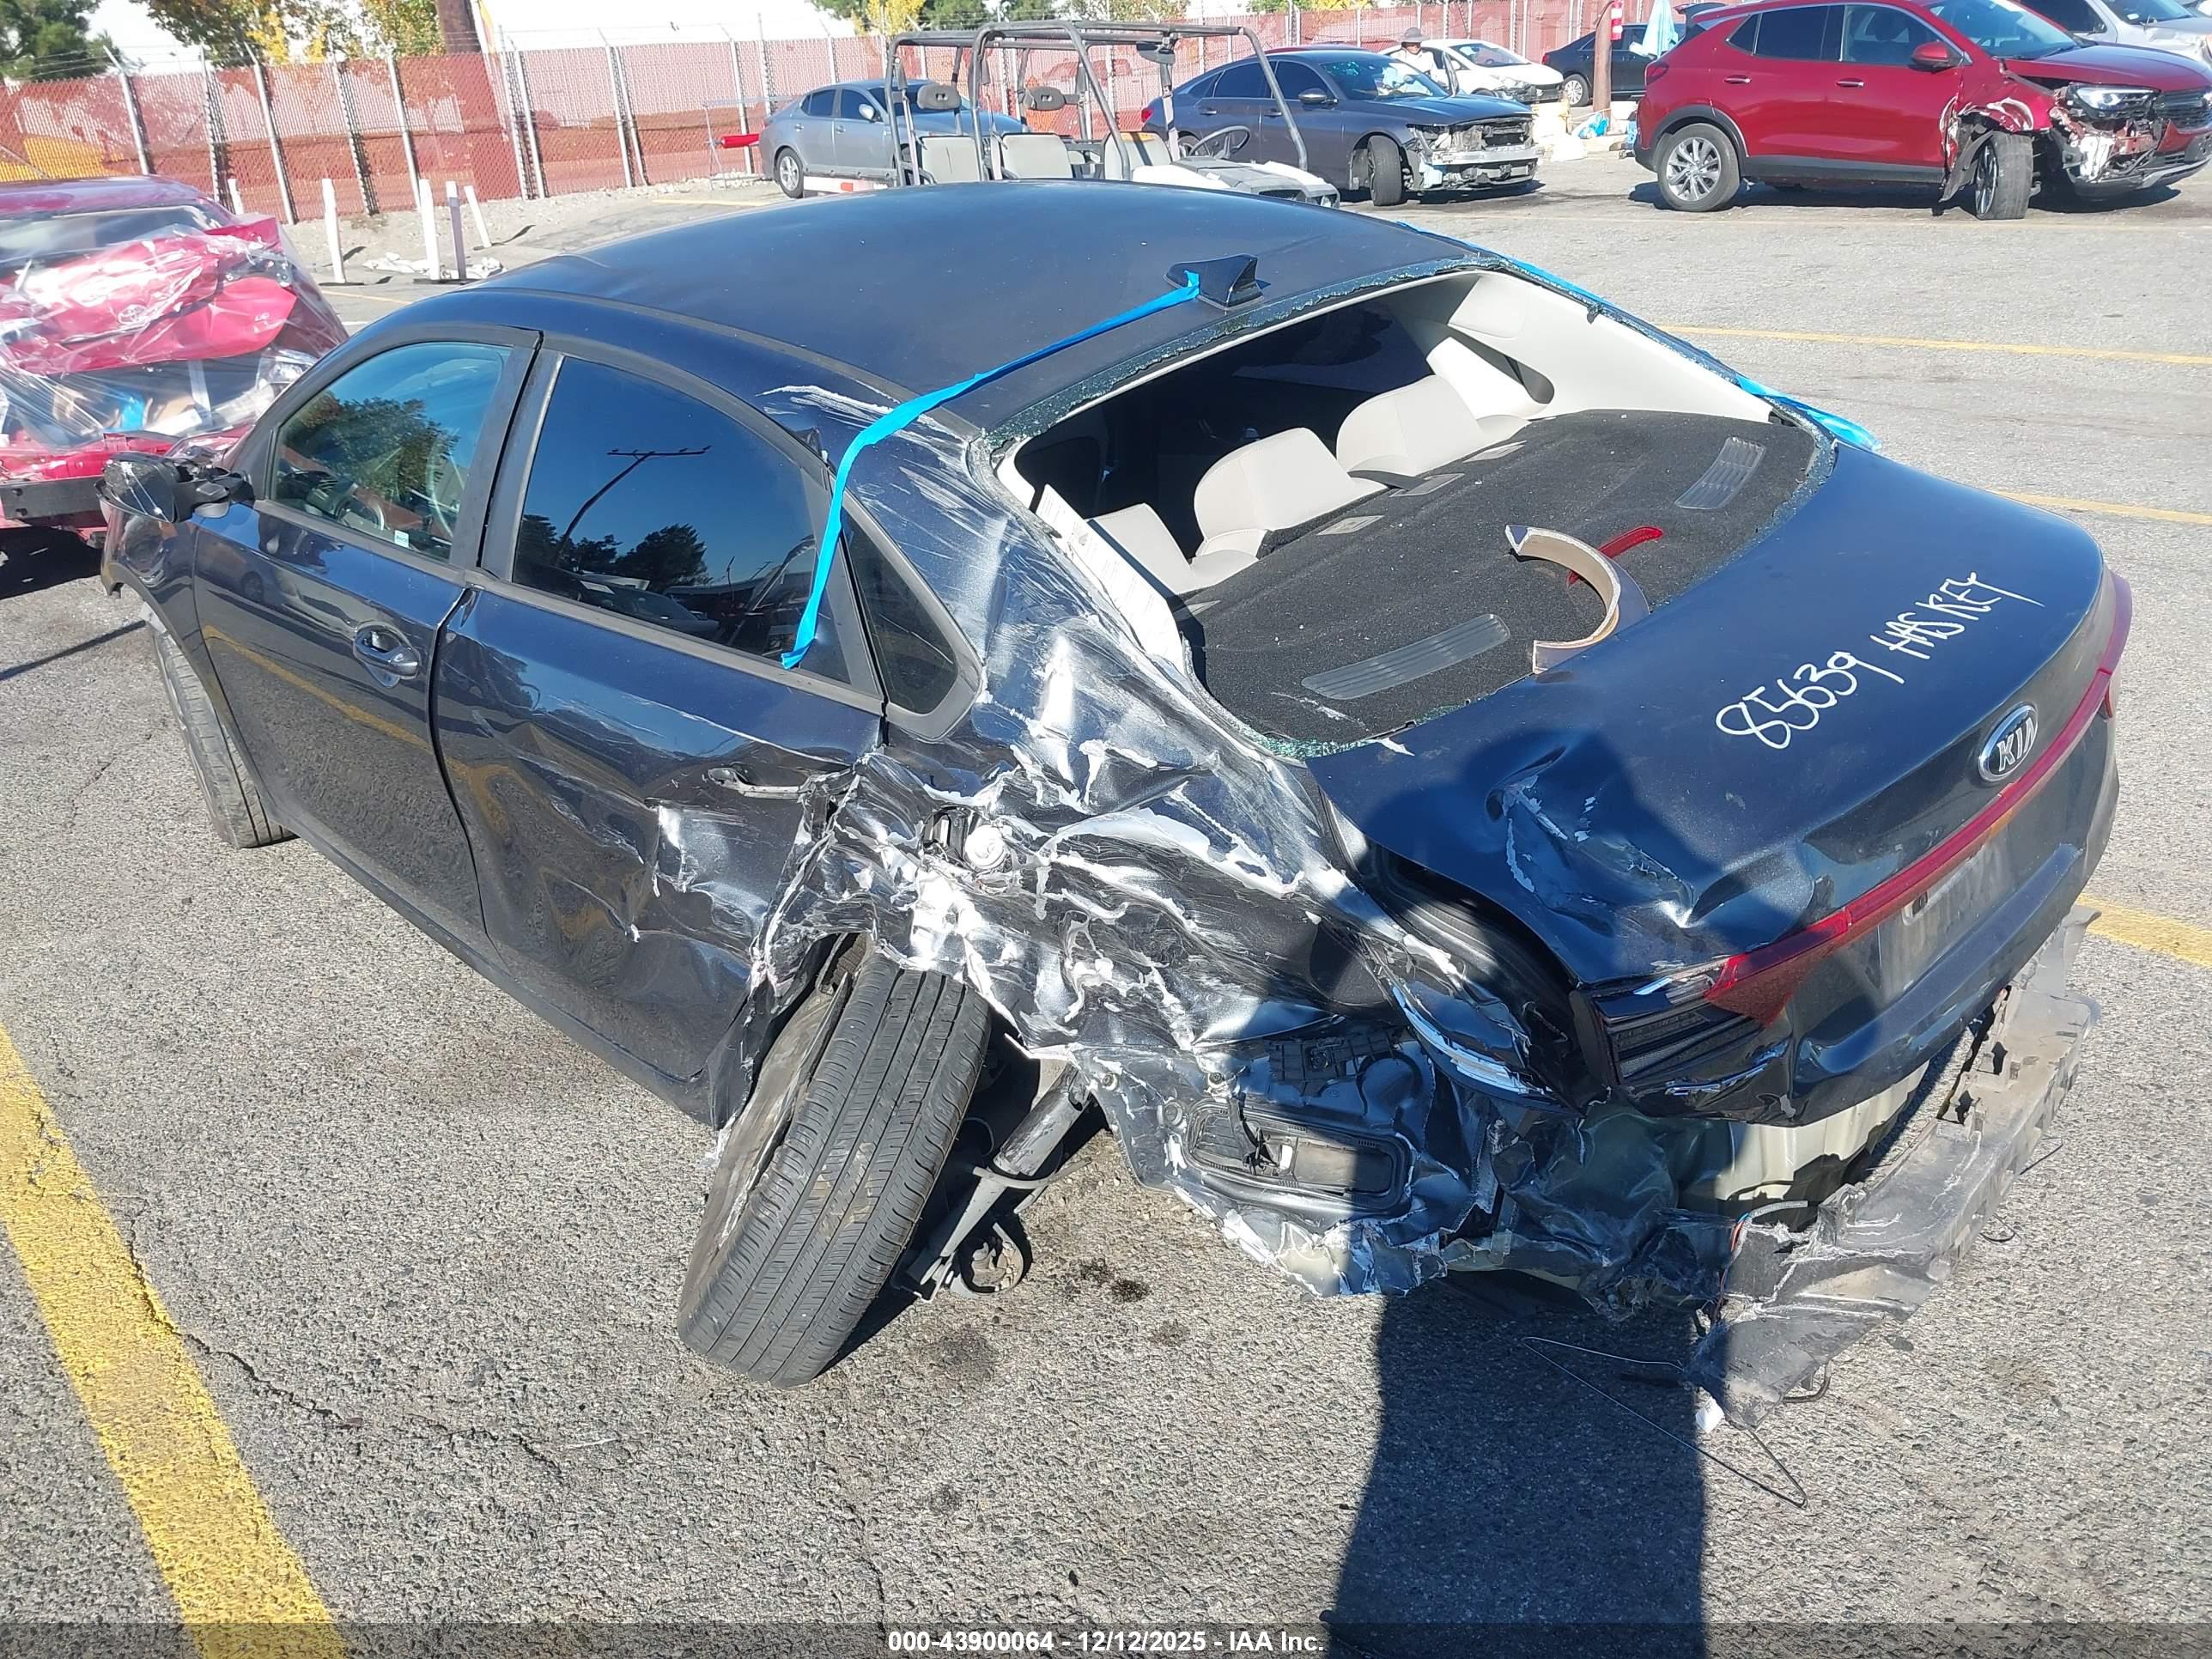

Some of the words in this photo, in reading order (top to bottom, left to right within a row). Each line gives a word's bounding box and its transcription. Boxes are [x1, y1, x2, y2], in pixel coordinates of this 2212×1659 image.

[1914, 571, 2045, 621] KEY
[1869, 611, 1966, 660] HAS
[1716, 650, 1905, 750] 85639
[1996, 717, 2034, 772] KIA
